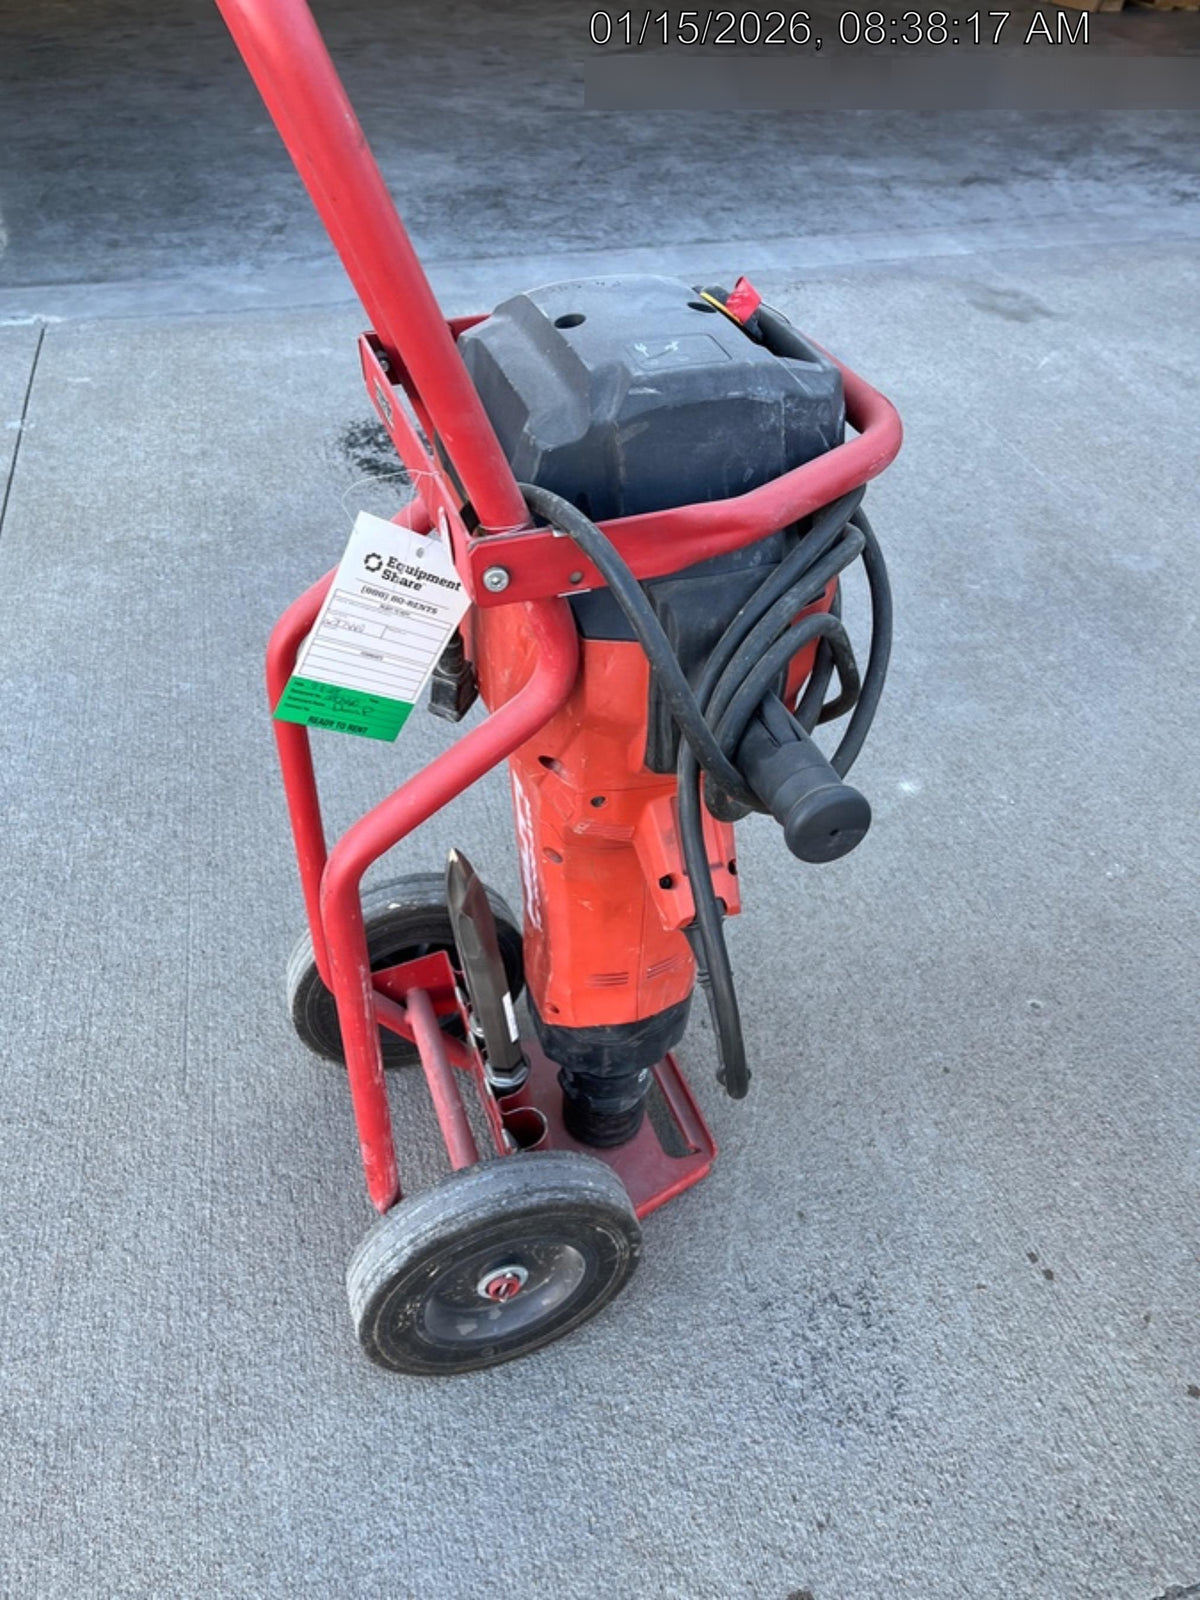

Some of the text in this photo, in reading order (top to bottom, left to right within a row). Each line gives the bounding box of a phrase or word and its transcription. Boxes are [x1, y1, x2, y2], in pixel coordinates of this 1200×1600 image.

[381, 569, 423, 592] Share
[386, 555, 462, 592] Equipment
[307, 715, 369, 734] READY TO RENT
